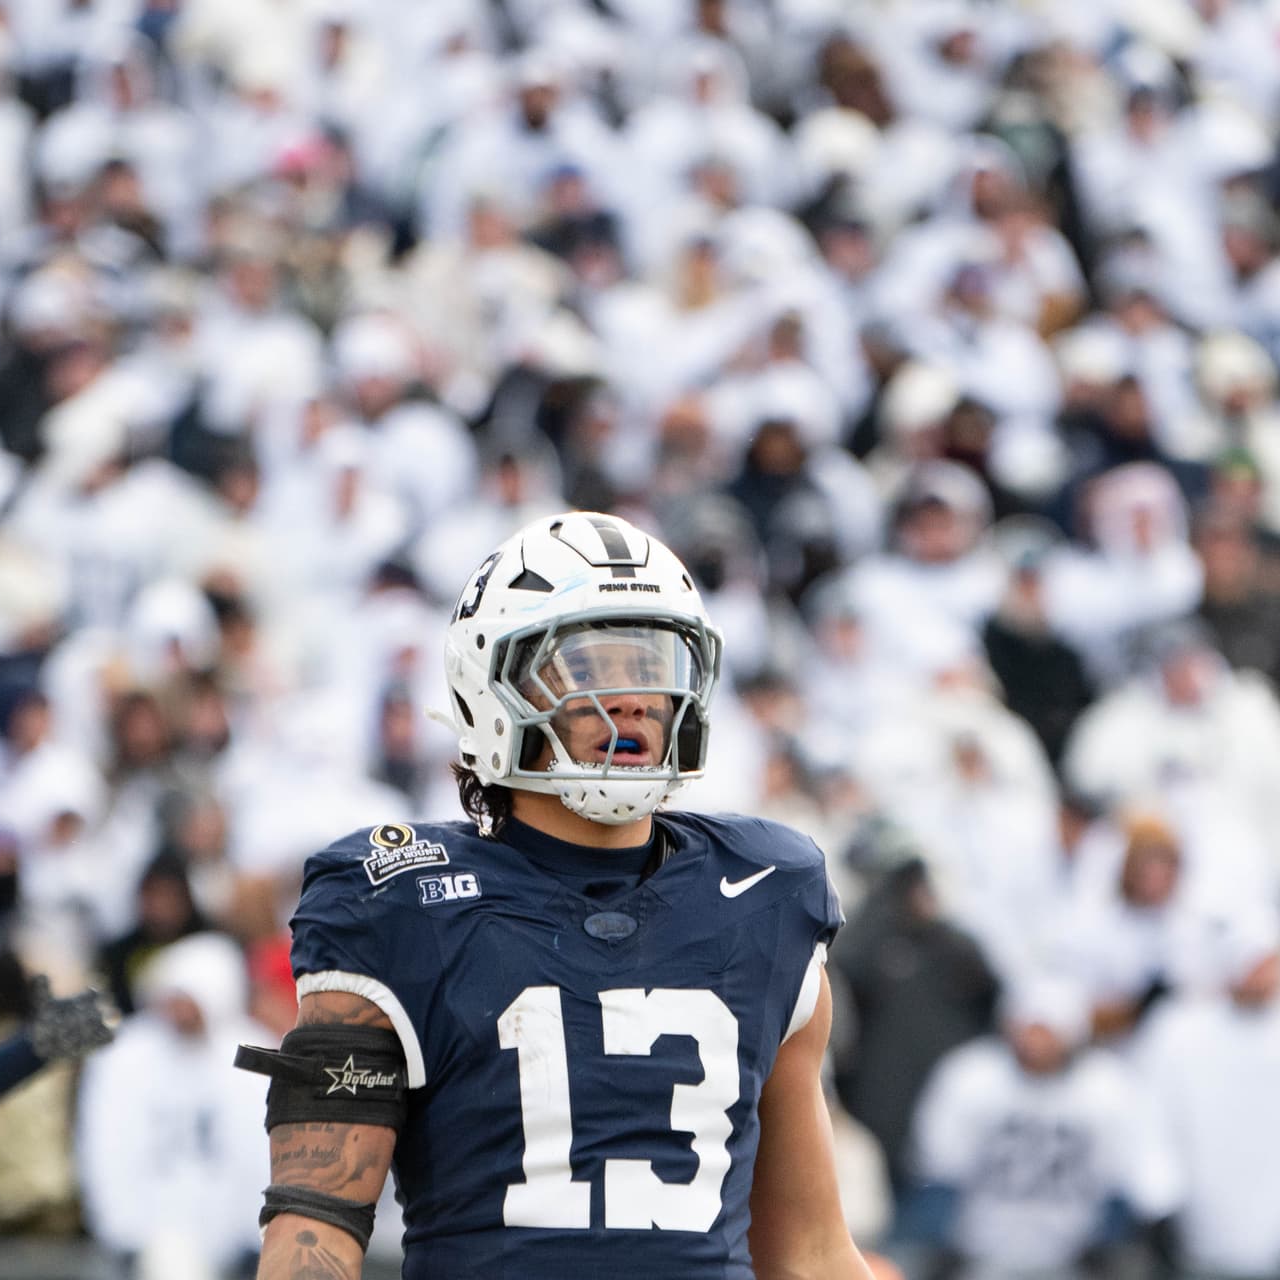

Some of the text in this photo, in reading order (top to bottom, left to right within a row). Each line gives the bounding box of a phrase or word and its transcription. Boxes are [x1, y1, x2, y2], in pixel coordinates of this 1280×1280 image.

[599, 583, 661, 593] PENN STATE
[377, 843, 425, 858] PLAYOFF
[369, 853, 401, 871] FIRST
[404, 847, 441, 859] ROUND
[341, 1072, 395, 1088] Douglas
[496, 985, 740, 1233] 13
